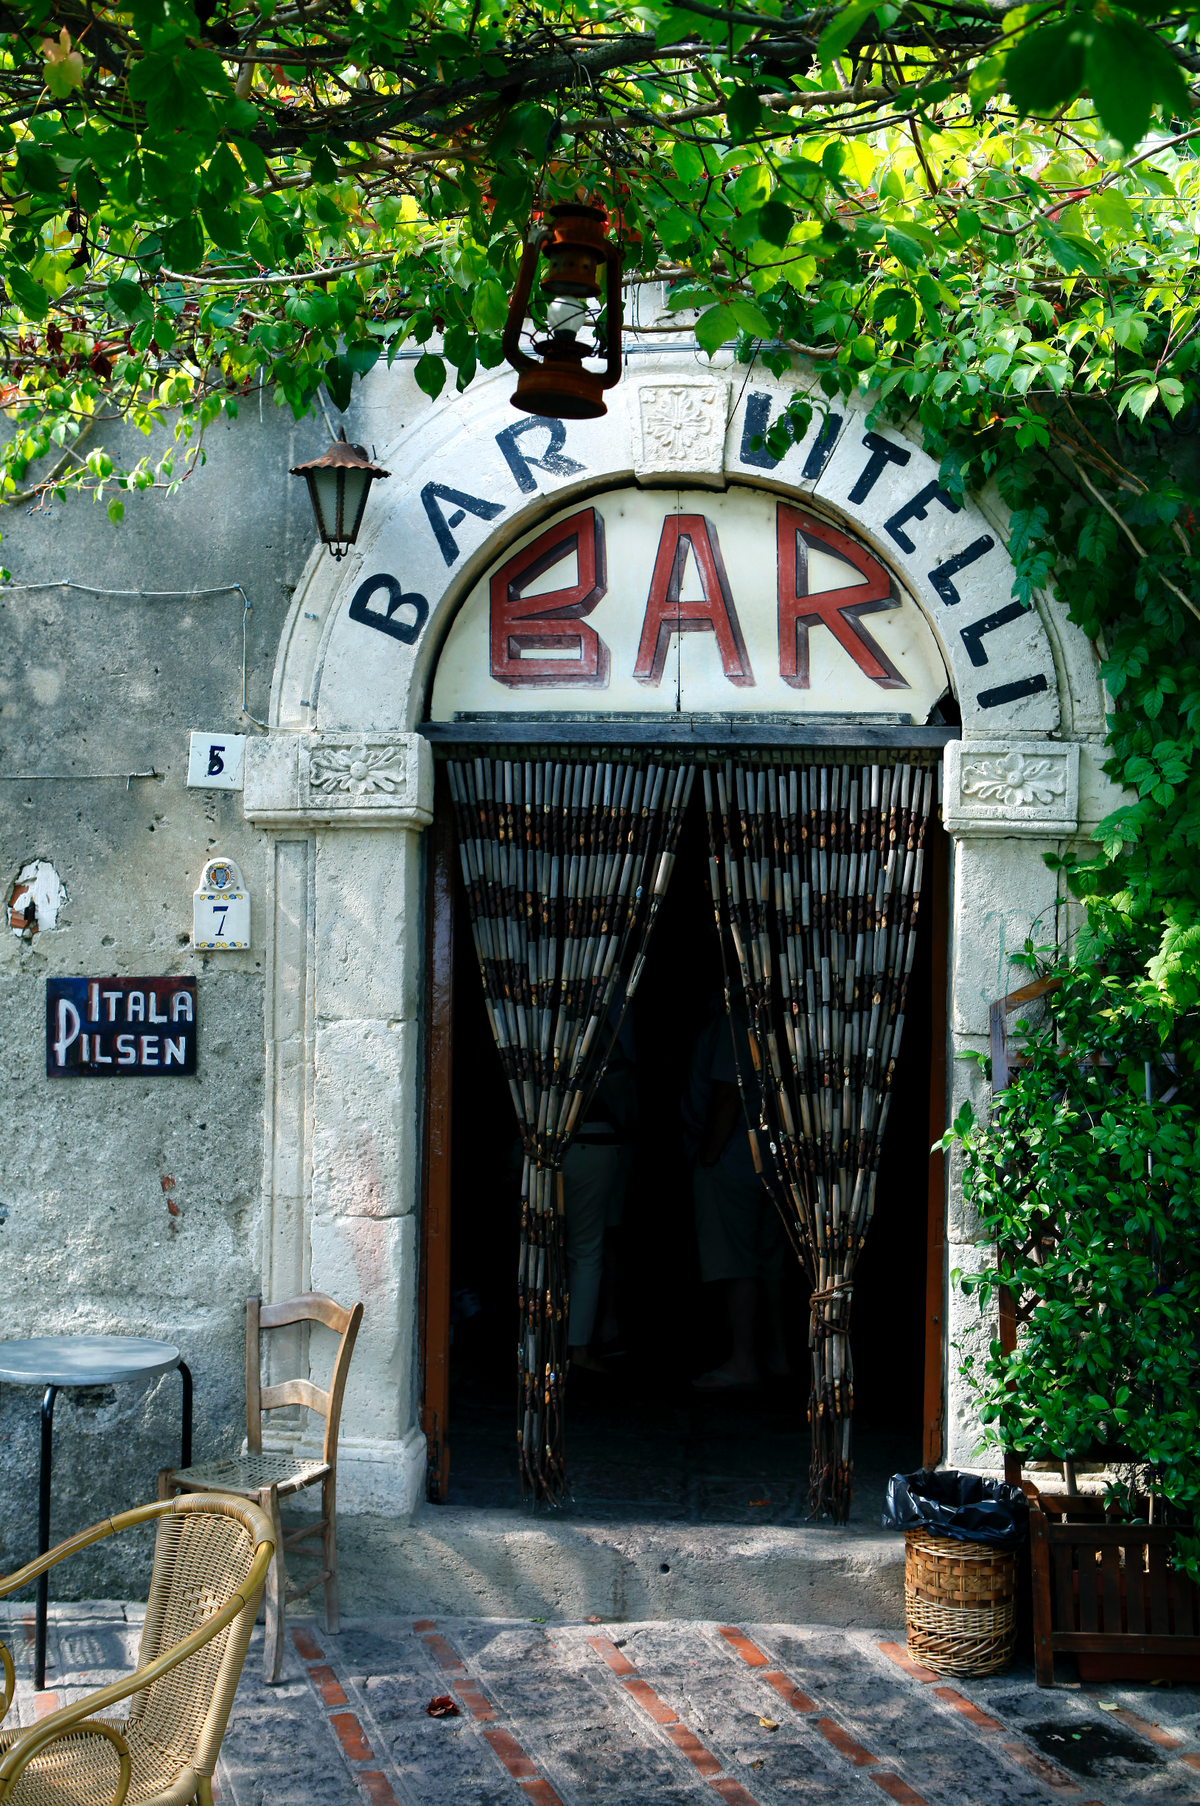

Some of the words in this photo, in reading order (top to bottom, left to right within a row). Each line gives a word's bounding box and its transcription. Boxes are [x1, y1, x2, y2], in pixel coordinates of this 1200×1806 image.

[349, 414, 588, 645] BAR
[489, 500, 912, 690] BAR
[207, 745, 226, 776] 5
[212, 905, 229, 936] 7
[88, 982, 194, 1024] ITALA
[53, 998, 187, 1067] PILSEN
